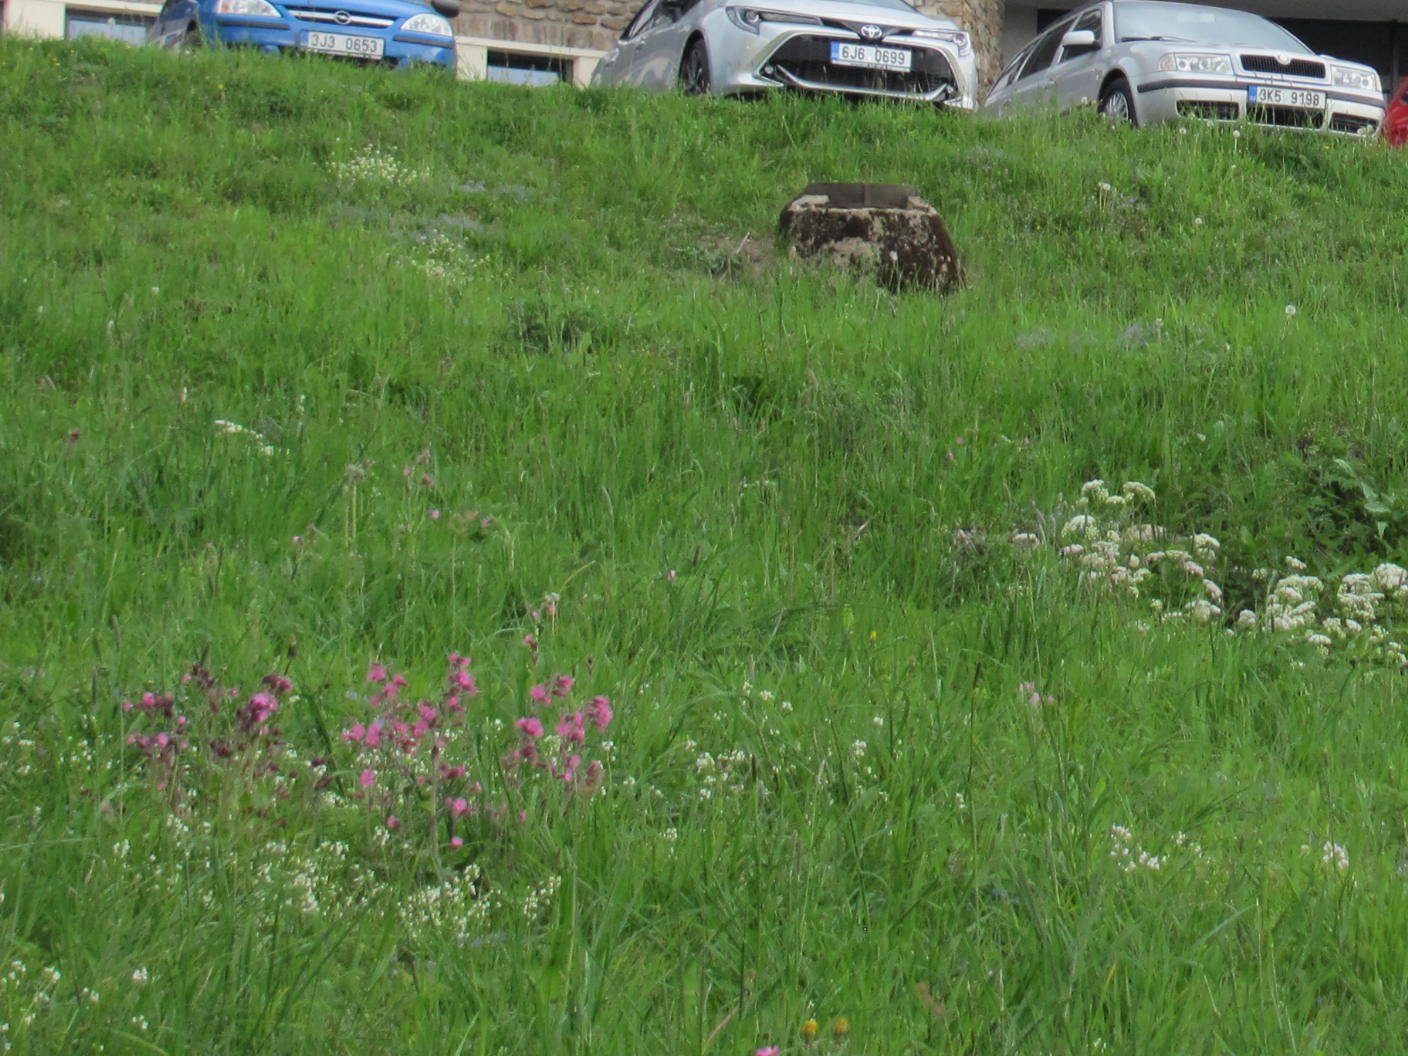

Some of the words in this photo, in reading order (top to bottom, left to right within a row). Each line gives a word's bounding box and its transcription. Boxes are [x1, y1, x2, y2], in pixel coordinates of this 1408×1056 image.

[310, 32, 336, 49] 3J3
[345, 38, 378, 53] 0653
[841, 45, 865, 60] 6J6
[874, 47, 906, 65] 0699
[1259, 88, 1281, 103] 3K5
[1290, 90, 1320, 106] 9198
